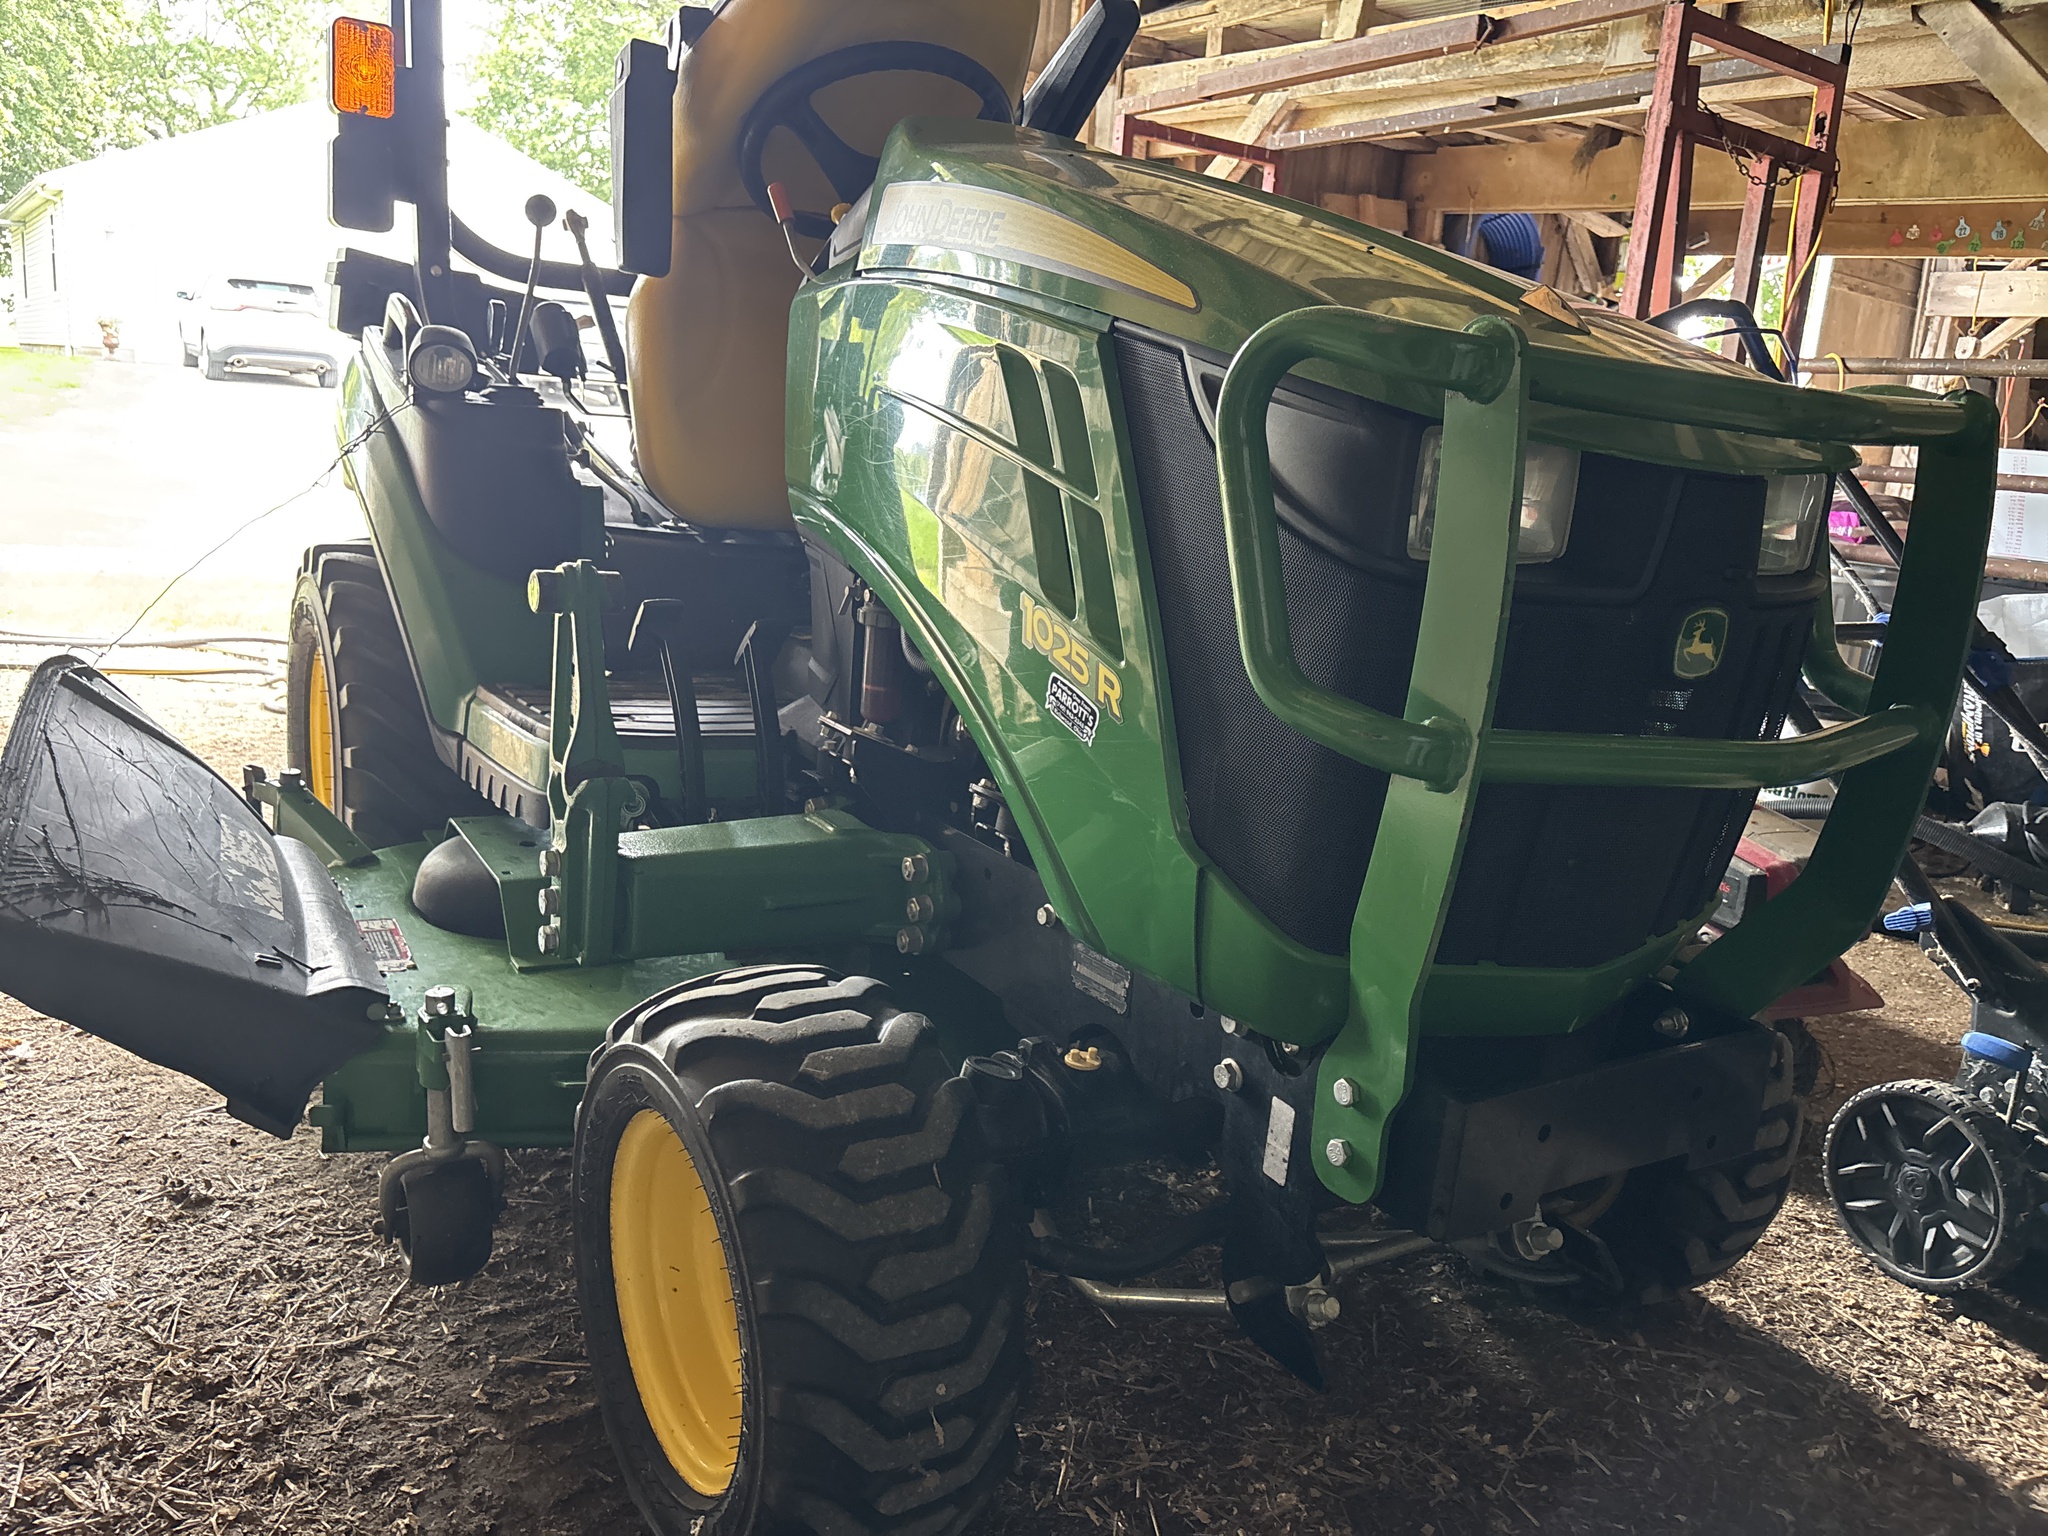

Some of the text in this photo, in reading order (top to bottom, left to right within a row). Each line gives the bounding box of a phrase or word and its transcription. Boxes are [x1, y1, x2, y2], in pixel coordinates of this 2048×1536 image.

[877, 198, 1007, 243] JOHN DEERE
[1022, 594, 1090, 686] 1025
[1051, 683, 1095, 727] PARROTT'S
